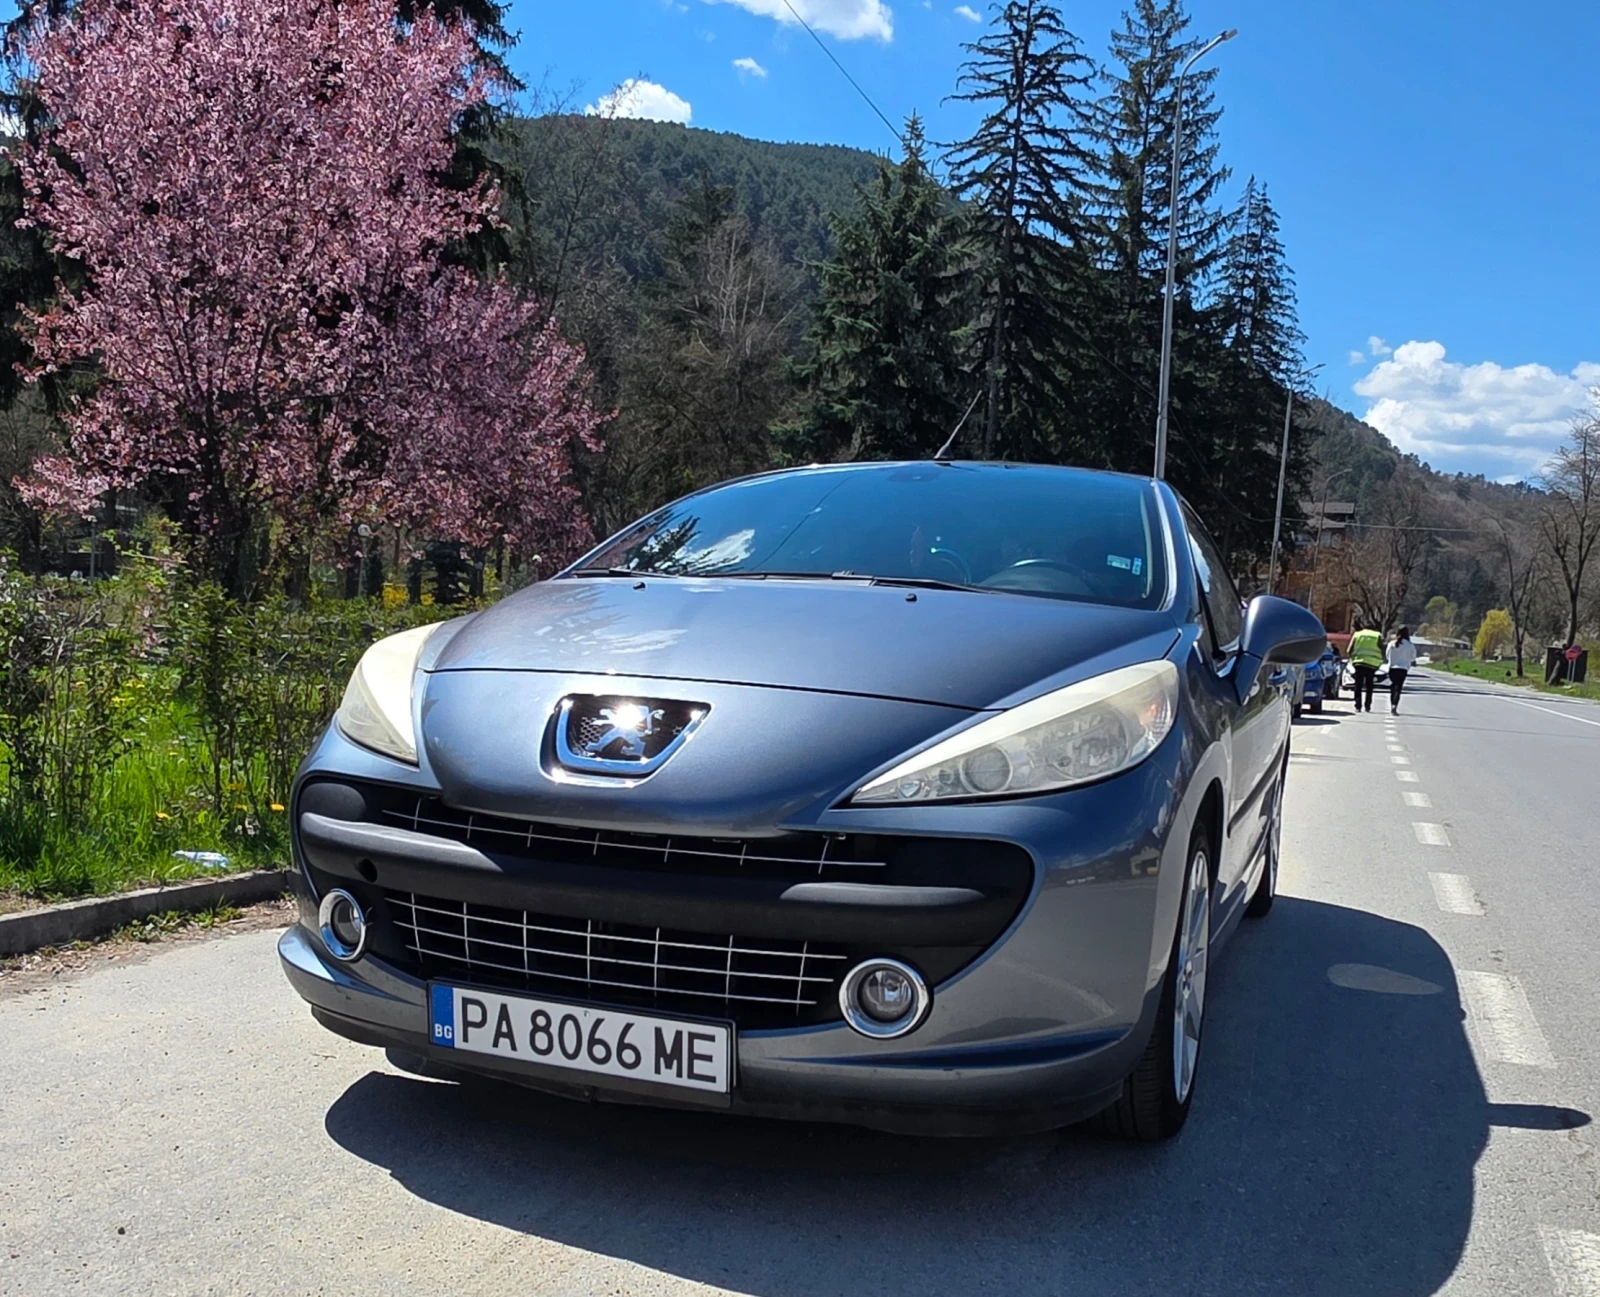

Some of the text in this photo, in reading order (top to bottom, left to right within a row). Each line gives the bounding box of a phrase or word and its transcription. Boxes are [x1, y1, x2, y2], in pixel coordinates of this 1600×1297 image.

[435, 1023, 452, 1039] BG
[461, 997, 717, 1083] PA 8066 ME
